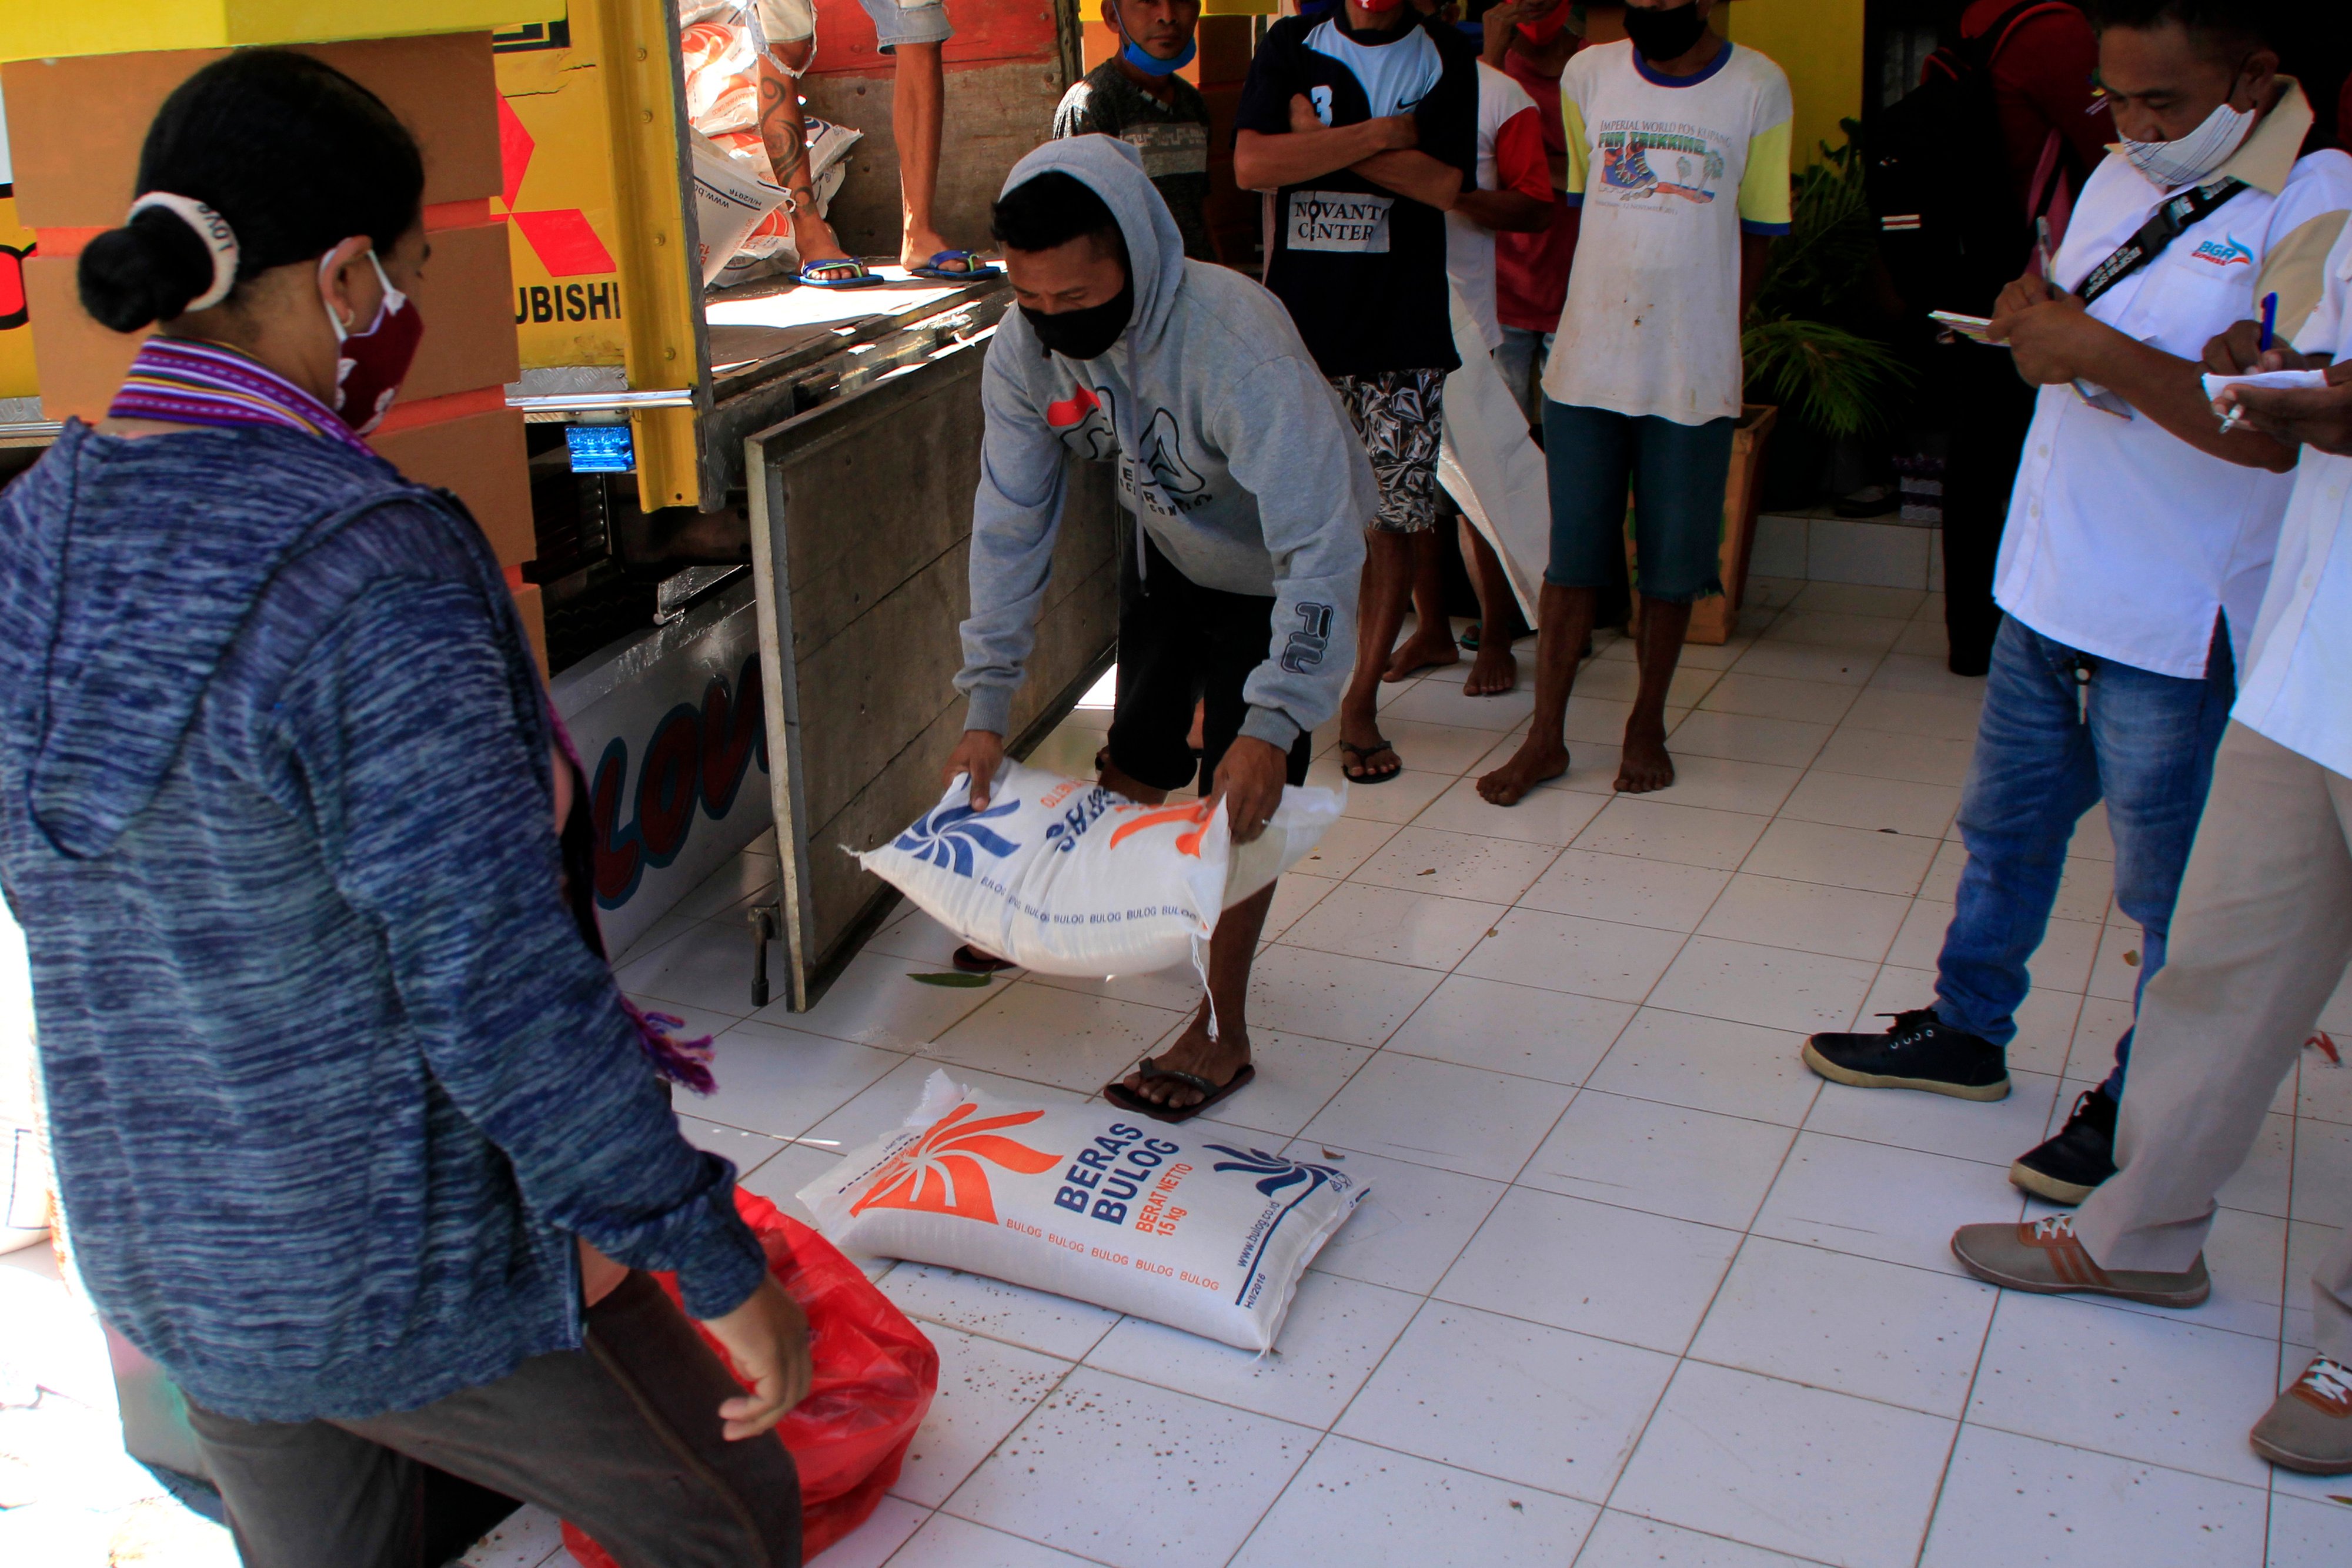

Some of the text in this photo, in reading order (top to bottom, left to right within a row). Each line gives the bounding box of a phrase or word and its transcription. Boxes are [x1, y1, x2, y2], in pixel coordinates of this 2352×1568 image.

[1600, 120, 1639, 132] IMPERIAL
[1642, 121, 1675, 133] WORLD
[1678, 123, 1695, 135] POS
[2198, 240, 2239, 260] BGR
[589, 652, 771, 911] LOV
[1054, 914, 1084, 924] BULOG
[1090, 911, 1121, 925] BULOG
[1127, 906, 1157, 921] BULOG
[1054, 1123, 1143, 1214] BERAS
[1091, 1138, 1180, 1225] BULOG
[1135, 1163, 1194, 1233] BERAT NETTO
[1006, 1218, 1220, 1291] BULOG BULOG BULOG BULOG BULOG
[1157, 1206, 1188, 1236] 15 kg
[1237, 1201, 1280, 1268] www.bulog.co.id
[1244, 1272, 1266, 1309] H/I/2016
